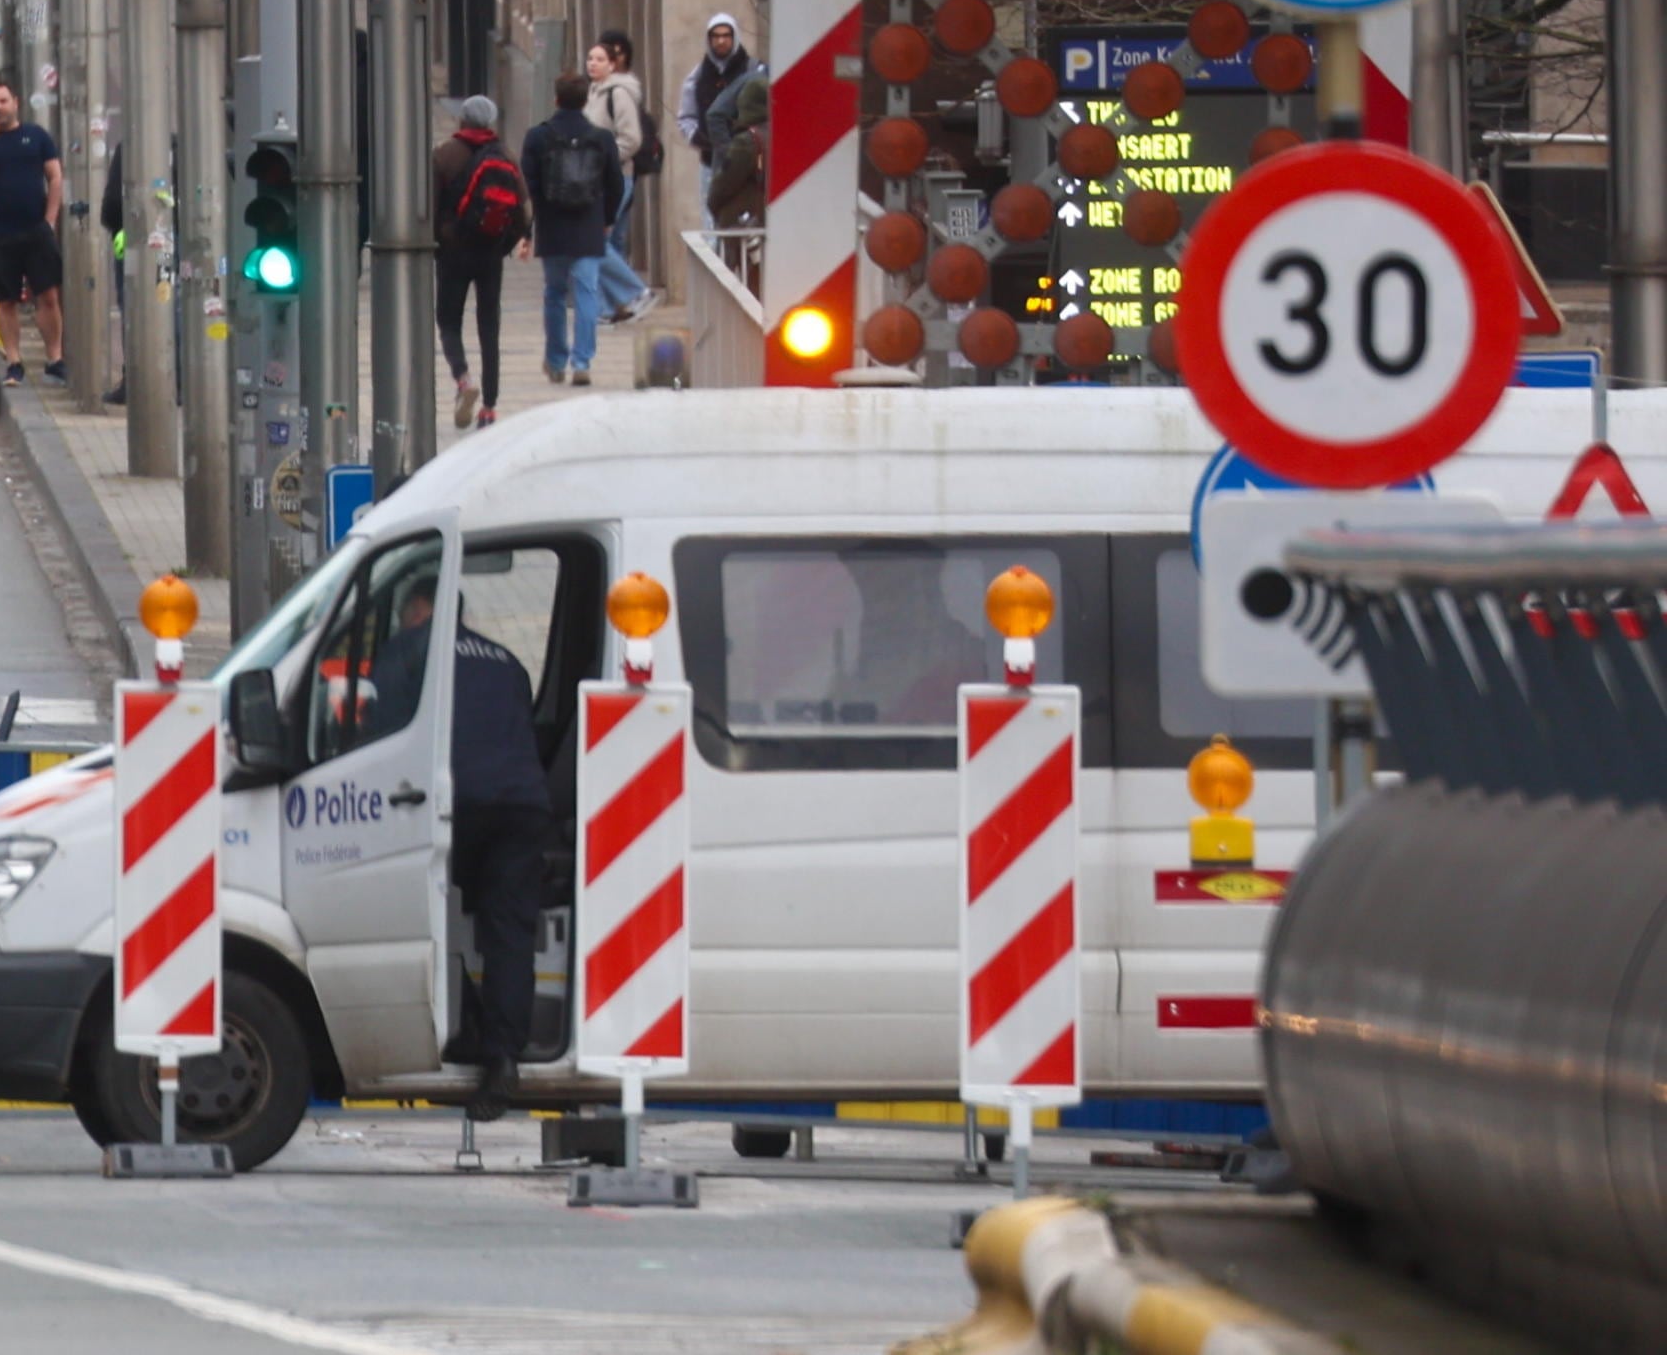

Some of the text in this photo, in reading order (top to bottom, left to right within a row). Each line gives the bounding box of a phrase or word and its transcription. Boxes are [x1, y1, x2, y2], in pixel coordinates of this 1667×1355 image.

[1113, 47, 1151, 66] Zone
[1117, 133, 1191, 160] NSAERT
[1087, 166, 1232, 194] STATION
[1089, 267, 1181, 294] ZONE RO
[1259, 249, 1429, 376] 30
[456, 637, 509, 662] olice
[315, 779, 382, 826] Police
